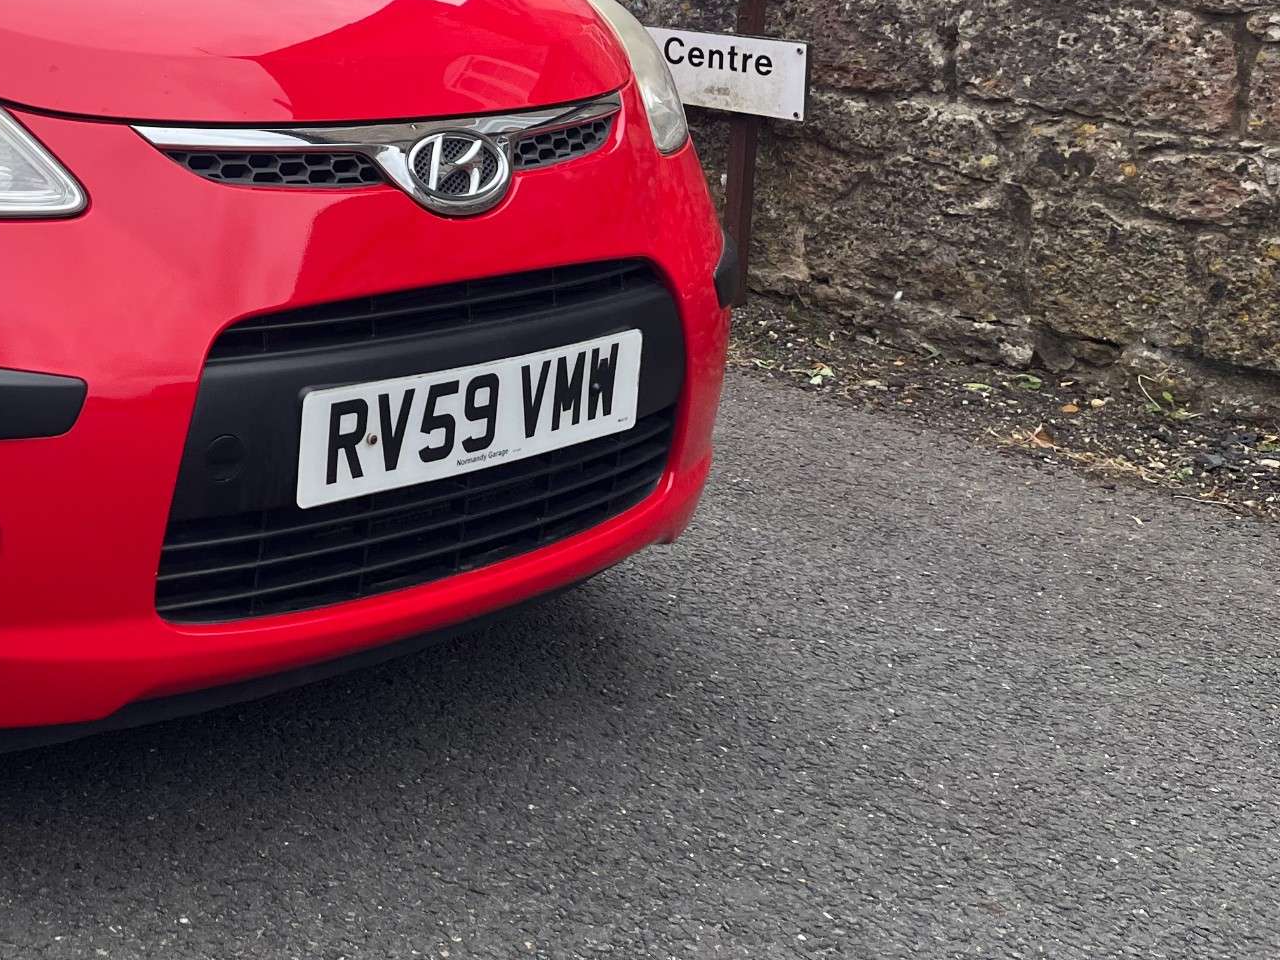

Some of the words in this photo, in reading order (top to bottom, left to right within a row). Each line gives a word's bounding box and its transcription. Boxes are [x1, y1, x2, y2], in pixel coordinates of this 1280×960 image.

[663, 36, 773, 76] Centre
[325, 372, 499, 485] RV59
[521, 342, 620, 438] VMW
[457, 454, 487, 466] Normandy
[488, 448, 509, 458] Garage
